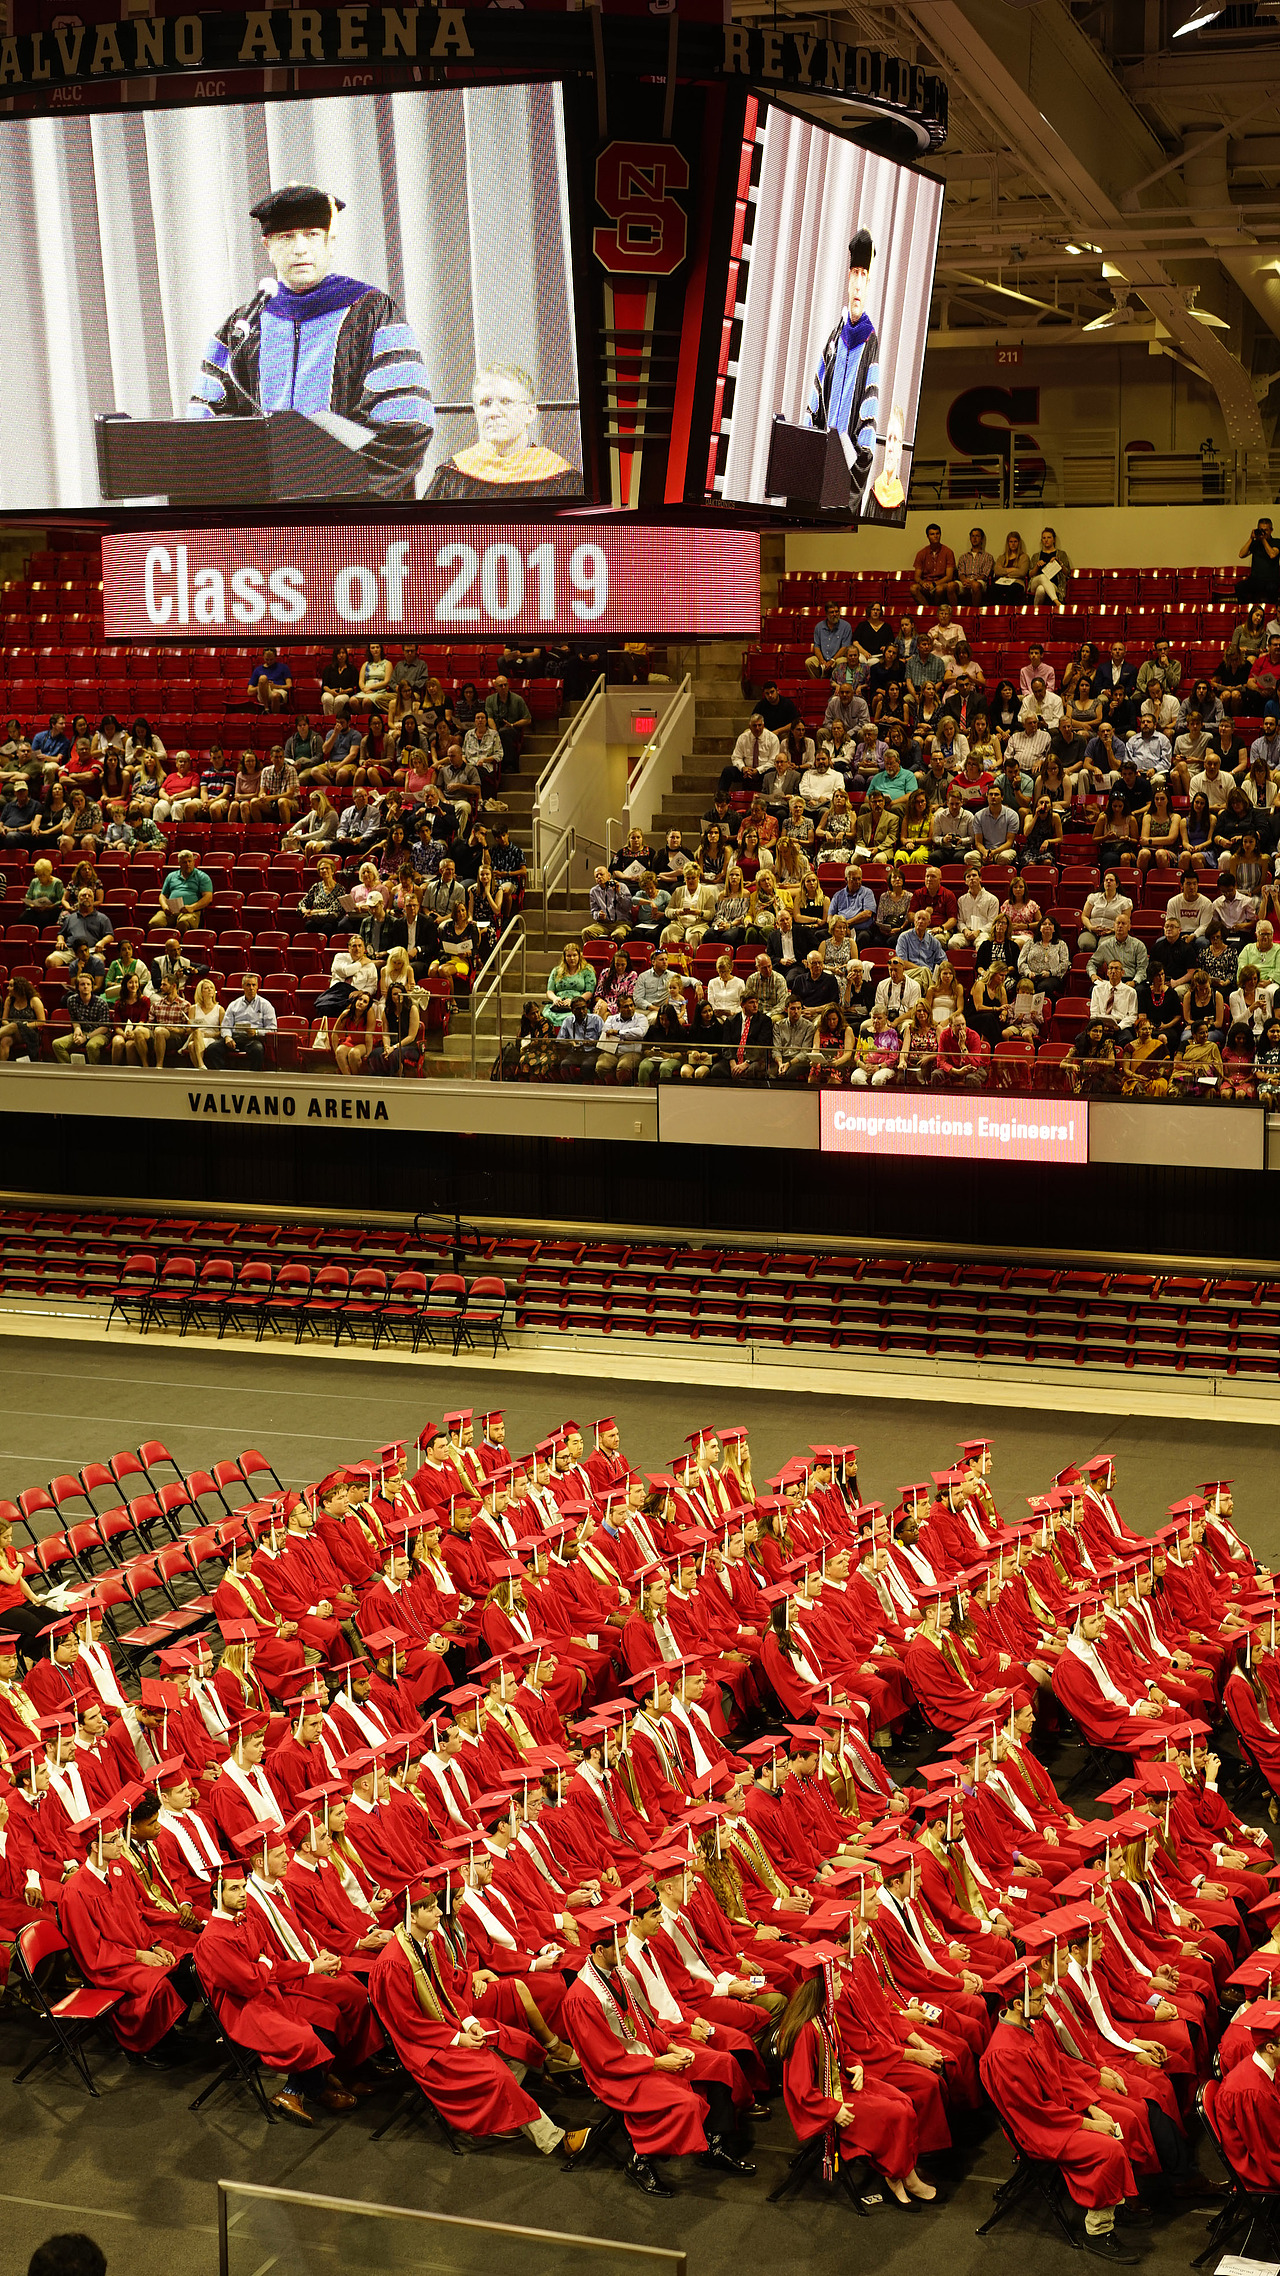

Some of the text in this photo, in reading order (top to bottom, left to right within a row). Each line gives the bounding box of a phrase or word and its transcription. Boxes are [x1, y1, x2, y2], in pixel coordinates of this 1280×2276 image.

[237, 8, 475, 60] ARENA
[722, 24, 925, 111] REYNOLDS
[194, 81, 226, 98] ACC
[342, 75, 374, 87] ACC
[52, 85, 82, 101] ACC
[998, 351, 1018, 363] 211
[144, 541, 609, 625] Class of 2019
[635, 717, 653, 733] EXIT
[187, 1093, 389, 1120] VALVANO ARENA
[833, 1111, 1075, 1143] Congratulations Engineers!
